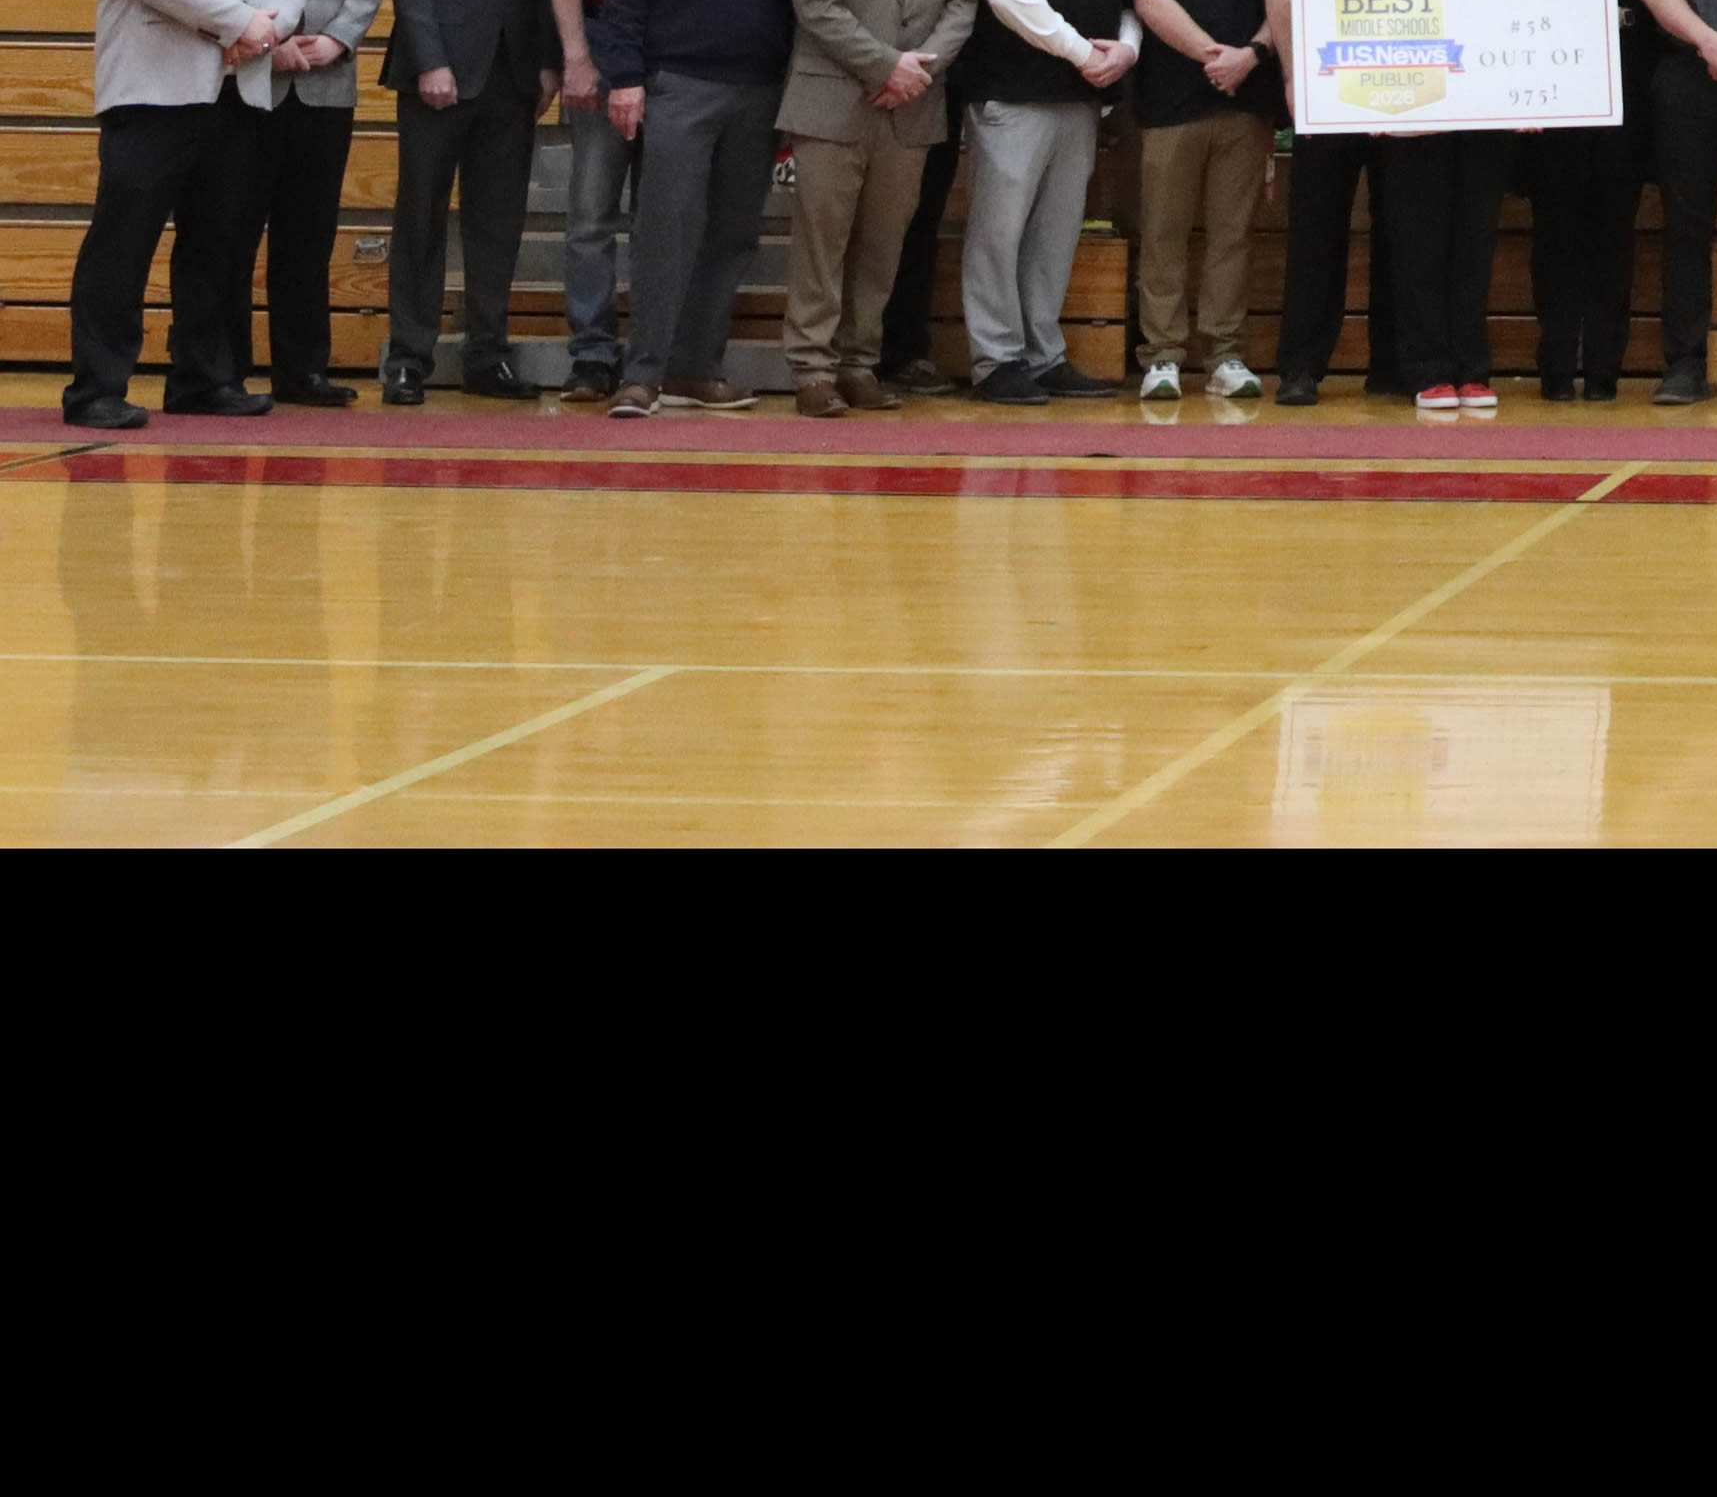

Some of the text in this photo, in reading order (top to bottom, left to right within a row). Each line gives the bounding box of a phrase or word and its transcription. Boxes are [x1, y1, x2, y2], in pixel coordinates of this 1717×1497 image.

[1340, 16, 1441, 37] MIDDLE SCHOOLS
[1478, 47, 1587, 68] OUT OF
[1359, 71, 1425, 87] PUBLIC
[1508, 83, 1561, 107] 975!
